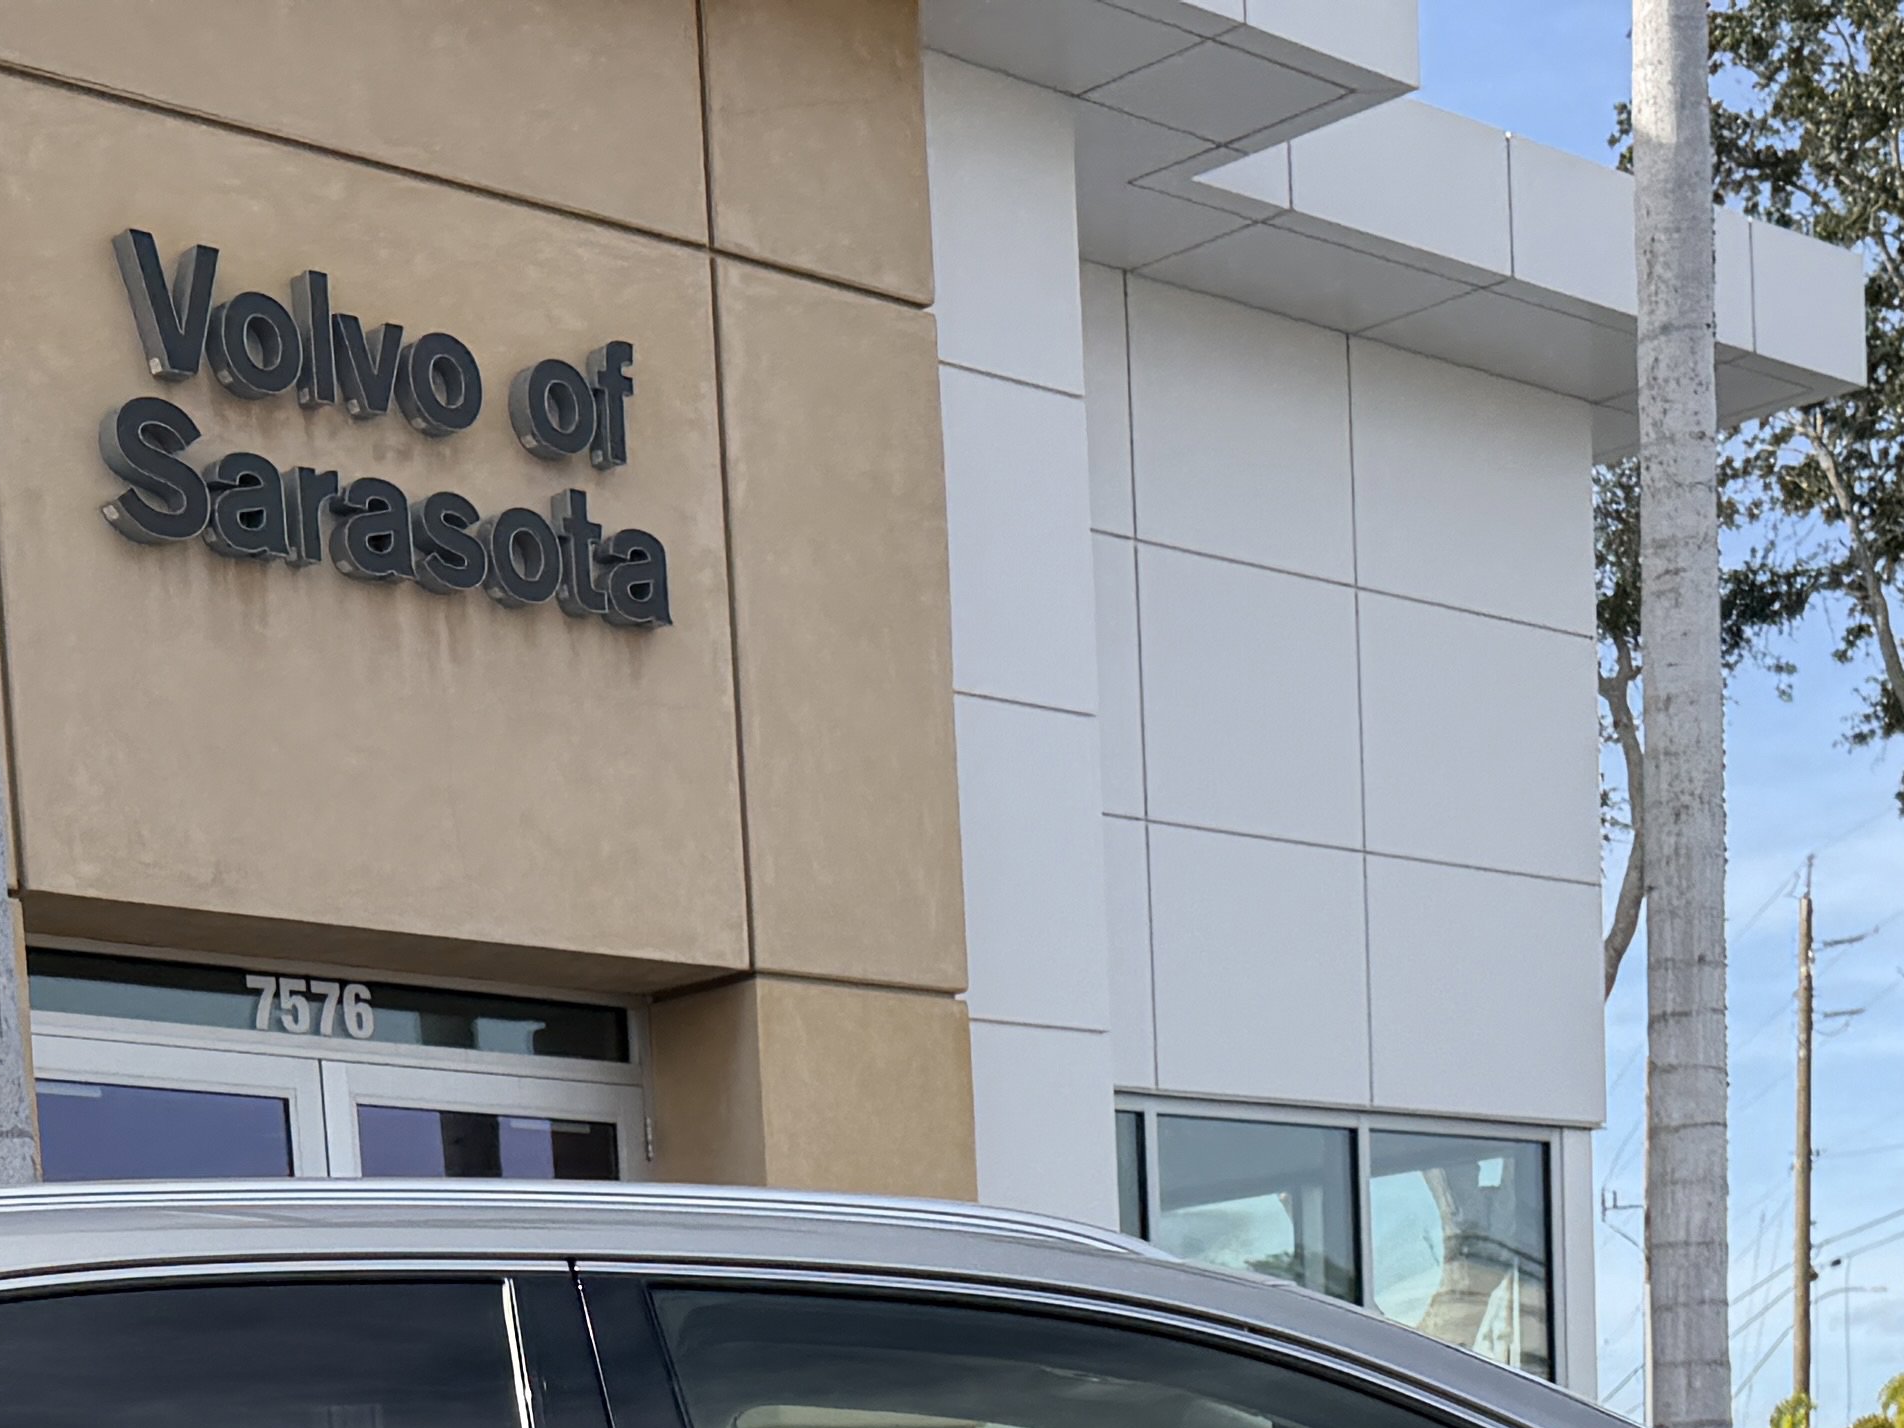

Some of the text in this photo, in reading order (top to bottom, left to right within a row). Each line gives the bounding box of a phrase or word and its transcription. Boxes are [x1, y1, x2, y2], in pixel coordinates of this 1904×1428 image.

[112, 228, 634, 470] Volvo of
[99, 396, 673, 629] Sarasota
[246, 974, 375, 1039] 7576
